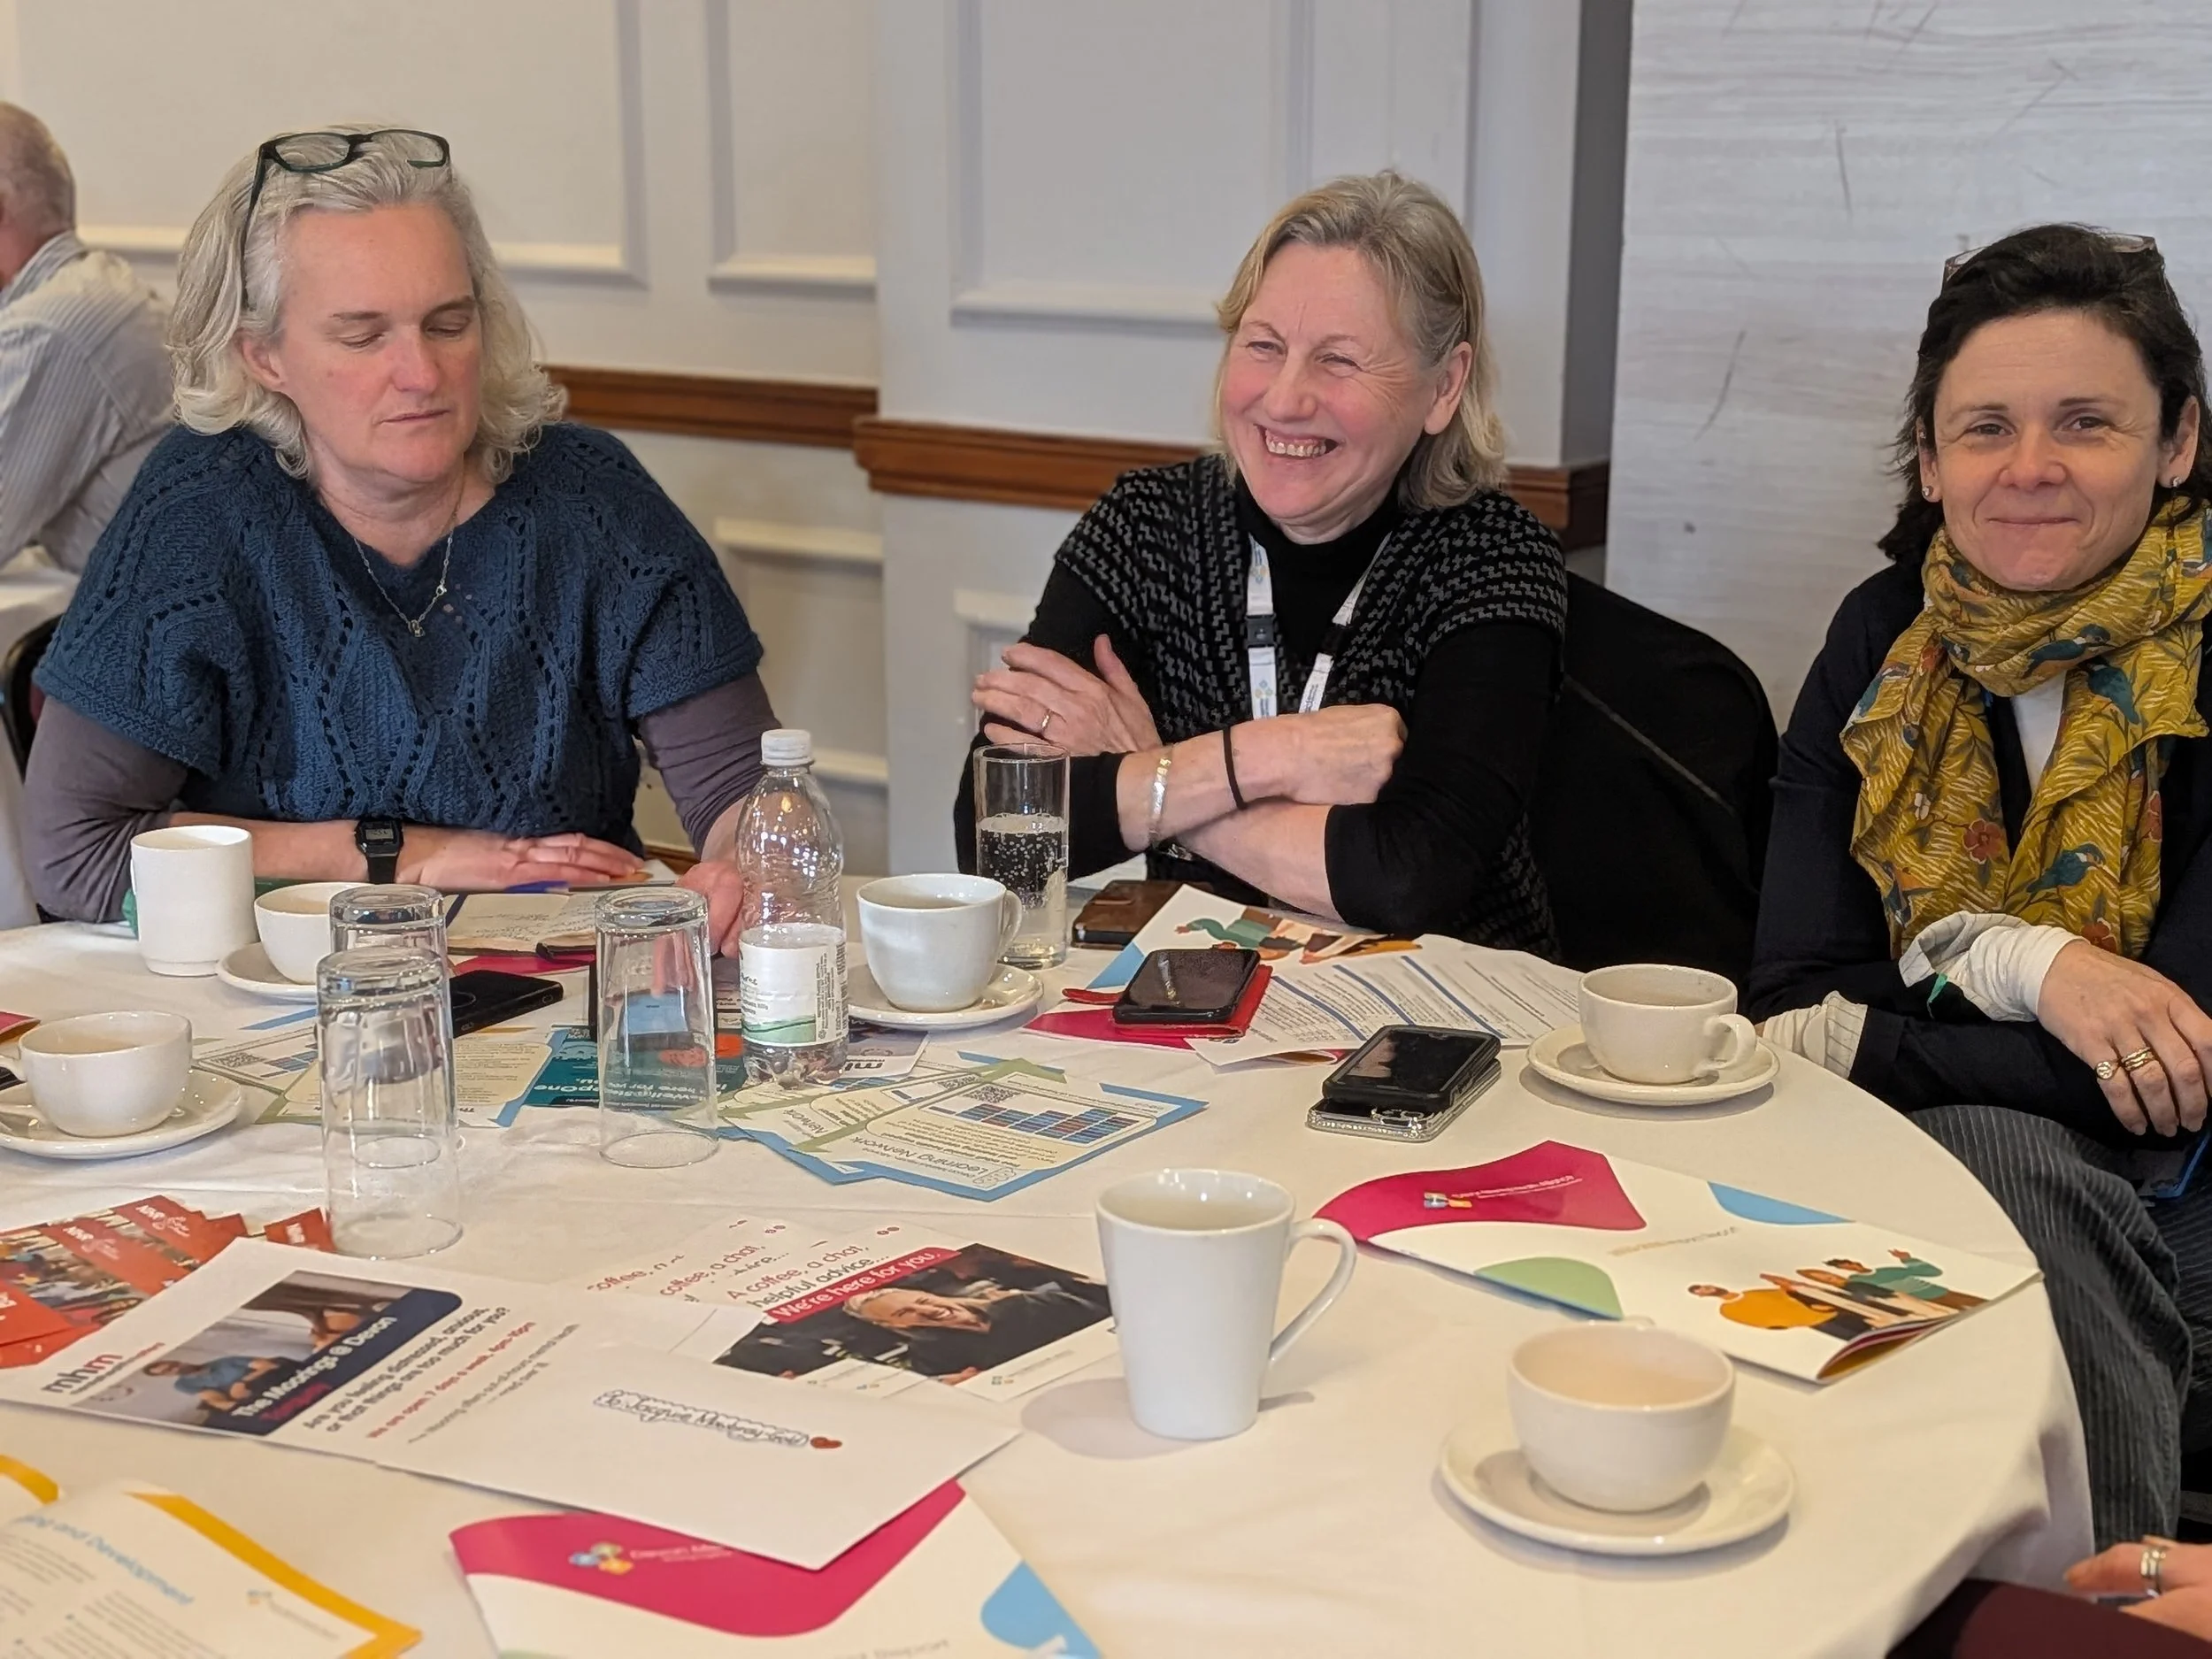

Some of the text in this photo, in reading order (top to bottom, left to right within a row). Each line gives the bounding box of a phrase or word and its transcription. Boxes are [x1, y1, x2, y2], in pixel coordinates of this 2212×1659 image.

[849, 1136, 989, 1175] Learning Network
[727, 1289, 747, 1302] A
[746, 1267, 809, 1294] coffee,
[806, 1260, 825, 1270] a
[824, 1244, 870, 1263] chat,
[747, 1279, 817, 1309] helpful
[816, 1255, 890, 1284] advice...
[773, 1250, 942, 1317] We're here for you.
[41, 1354, 123, 1393] mhm
[231, 1398, 273, 1417] The
[263, 1356, 339, 1400] Moorings
[329, 1345, 353, 1356] @
[342, 1317, 398, 1347] Devon
[326, 1422, 342, 1432] or
[437, 1334, 472, 1356] much
[463, 1323, 487, 1334] for
[481, 1306, 511, 1325] you?
